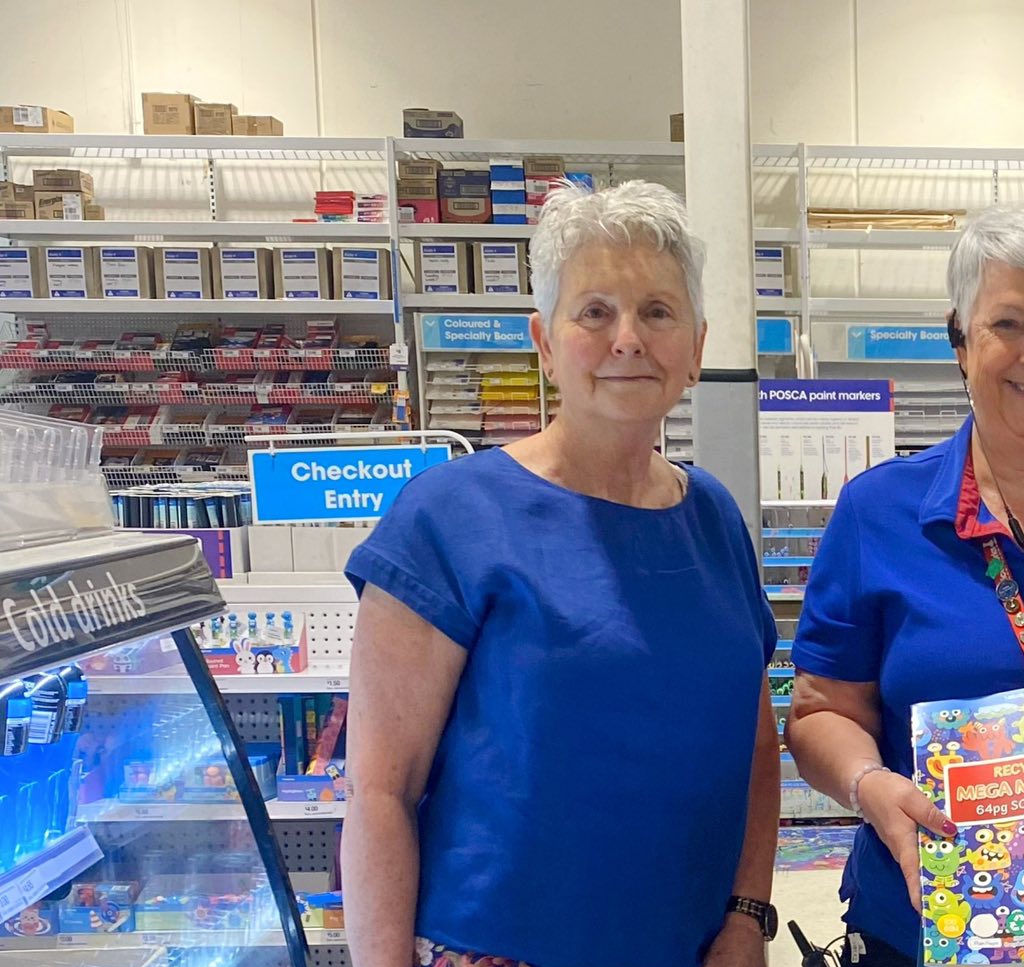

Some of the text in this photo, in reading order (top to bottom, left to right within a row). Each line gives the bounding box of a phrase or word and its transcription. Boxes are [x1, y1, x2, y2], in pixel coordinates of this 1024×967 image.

[444, 319, 501, 328] Coloured &
[445, 331, 524, 342] Specialty Board
[870, 329, 918, 342] Specialty
[769, 390, 807, 401] POSCA
[809, 390, 838, 402] paint
[838, 390, 881, 401] markers
[291, 459, 413, 482] Checkout
[324, 489, 384, 512] Entry
[2, 571, 146, 651] Cold drinks
[956, 782, 1013, 802] MEGA
[976, 803, 1008, 816] 64pg
